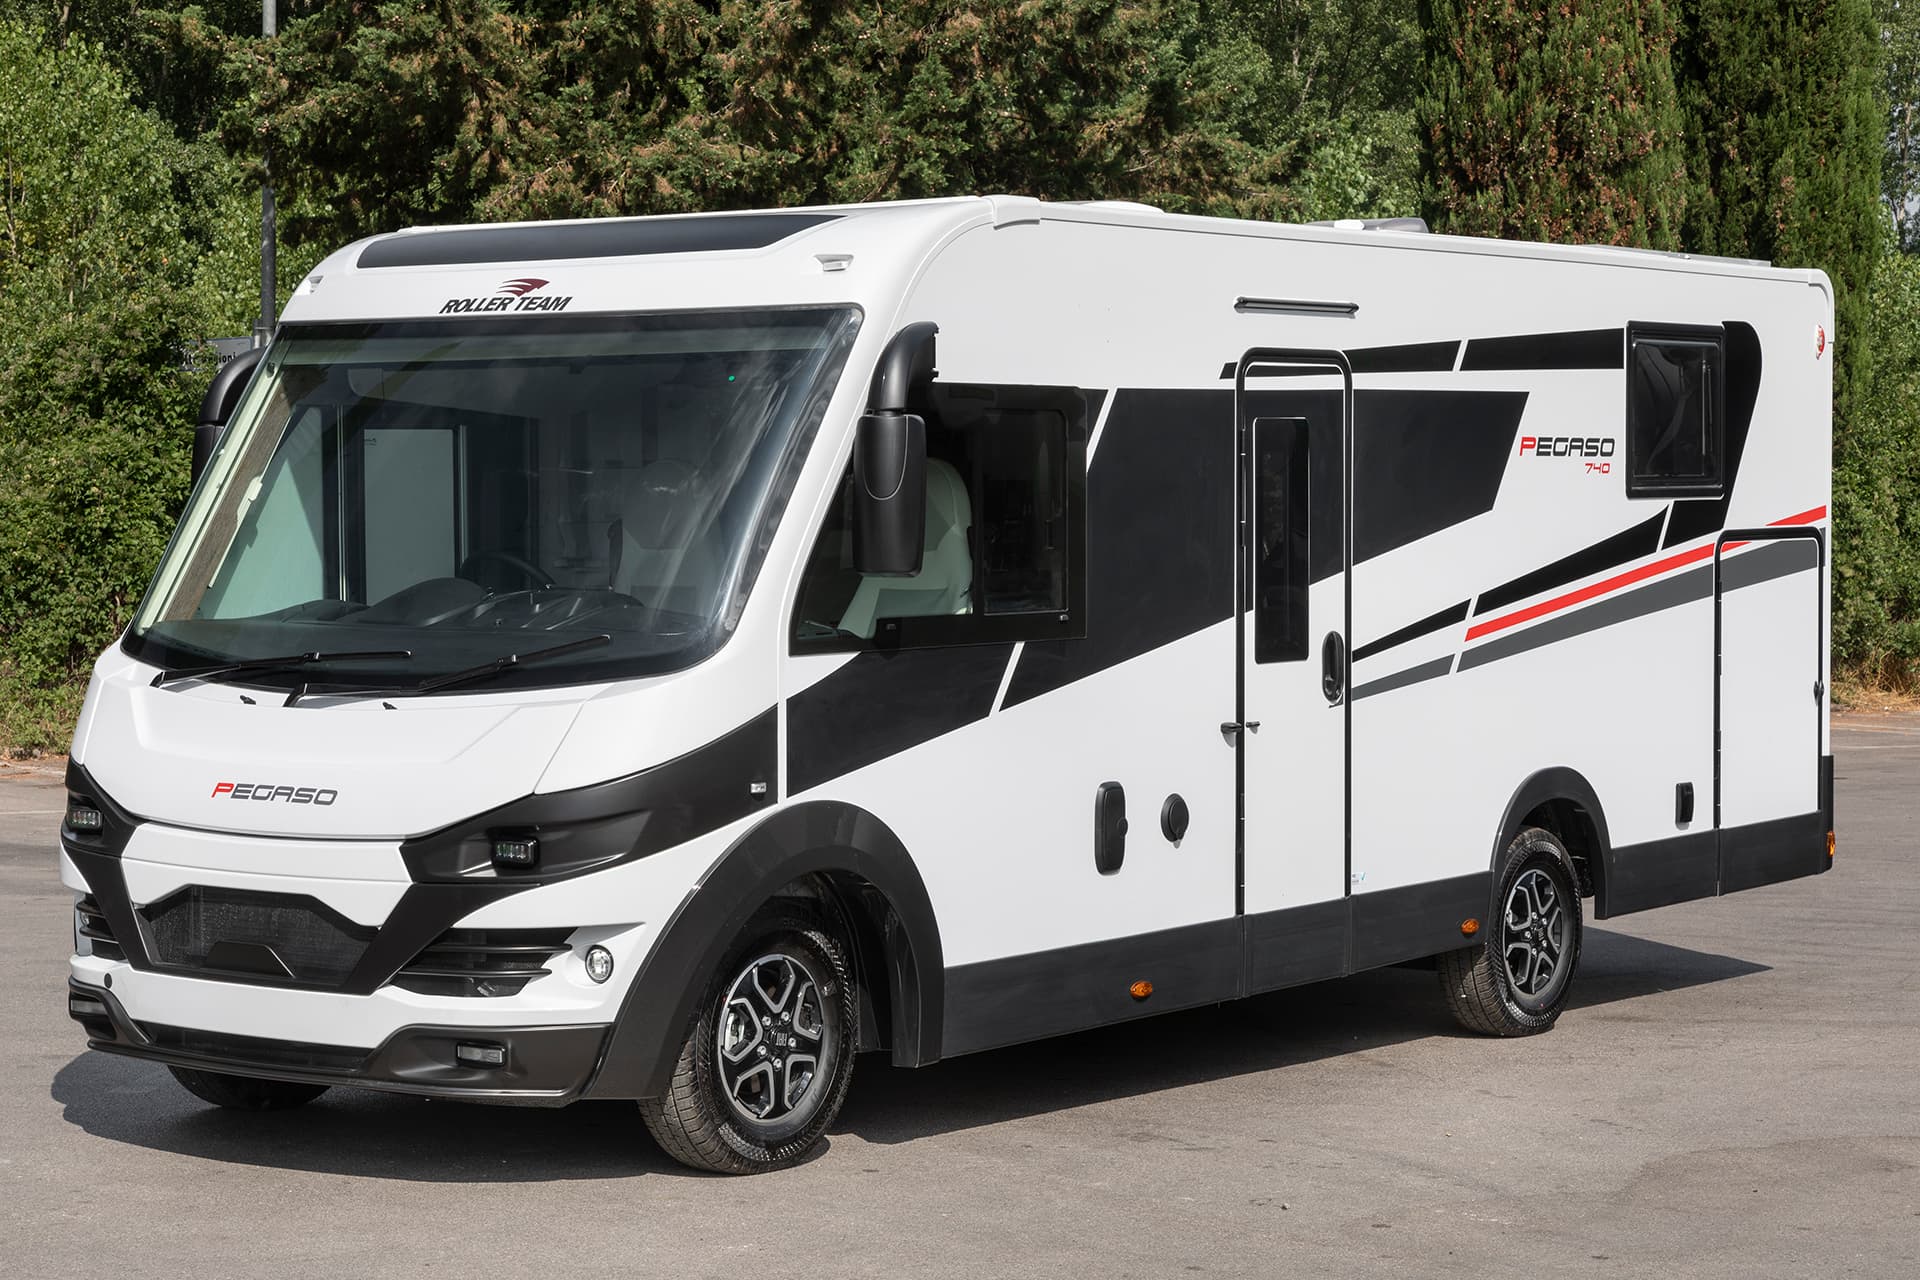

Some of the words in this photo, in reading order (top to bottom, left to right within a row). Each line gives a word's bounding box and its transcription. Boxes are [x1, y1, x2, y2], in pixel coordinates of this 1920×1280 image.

[438, 297, 515, 315] ROLLER
[513, 296, 573, 312] TEAM
[1519, 436, 1616, 457] PEGASO
[1584, 462, 1611, 475] 740
[210, 782, 338, 806] PEGASO
